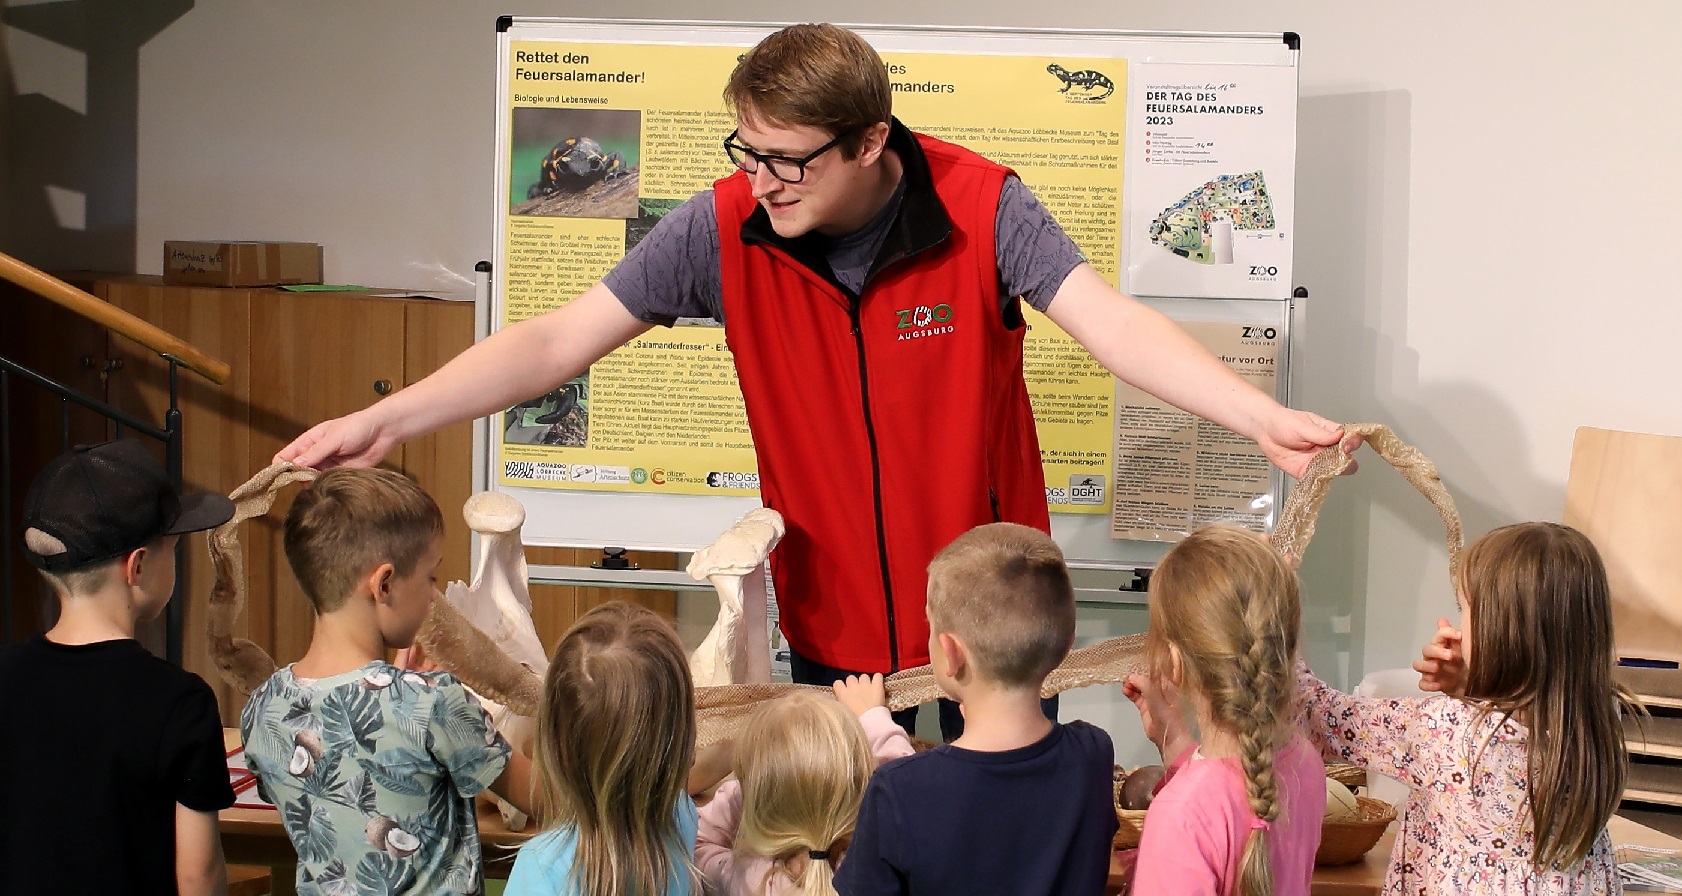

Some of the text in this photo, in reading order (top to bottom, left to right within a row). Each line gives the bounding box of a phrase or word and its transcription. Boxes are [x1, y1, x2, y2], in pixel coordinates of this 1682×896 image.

[516, 51, 589, 64] Rettet den
[515, 68, 646, 84] Feuersalamander!
[891, 80, 955, 93] manders
[514, 94, 609, 104] Biologie und Lebensweise
[1146, 92, 1217, 101] DER TAG DES
[1146, 103, 1264, 115] FEUERSALAMANDERS
[1146, 116, 1174, 125] 2023
[1249, 266, 1277, 276] ZOO
[896, 303, 953, 328] ZOO
[897, 325, 954, 341] AUGSBURG
[1242, 326, 1276, 340] ZOO
[1257, 356, 1274, 365] Ort
[1063, 450, 1077, 458] sich
[1069, 458, 1105, 467] beitragen!
[723, 473, 757, 482] FROGS
[1072, 488, 1103, 497] DGHT
[1047, 497, 1068, 505] ENDS
